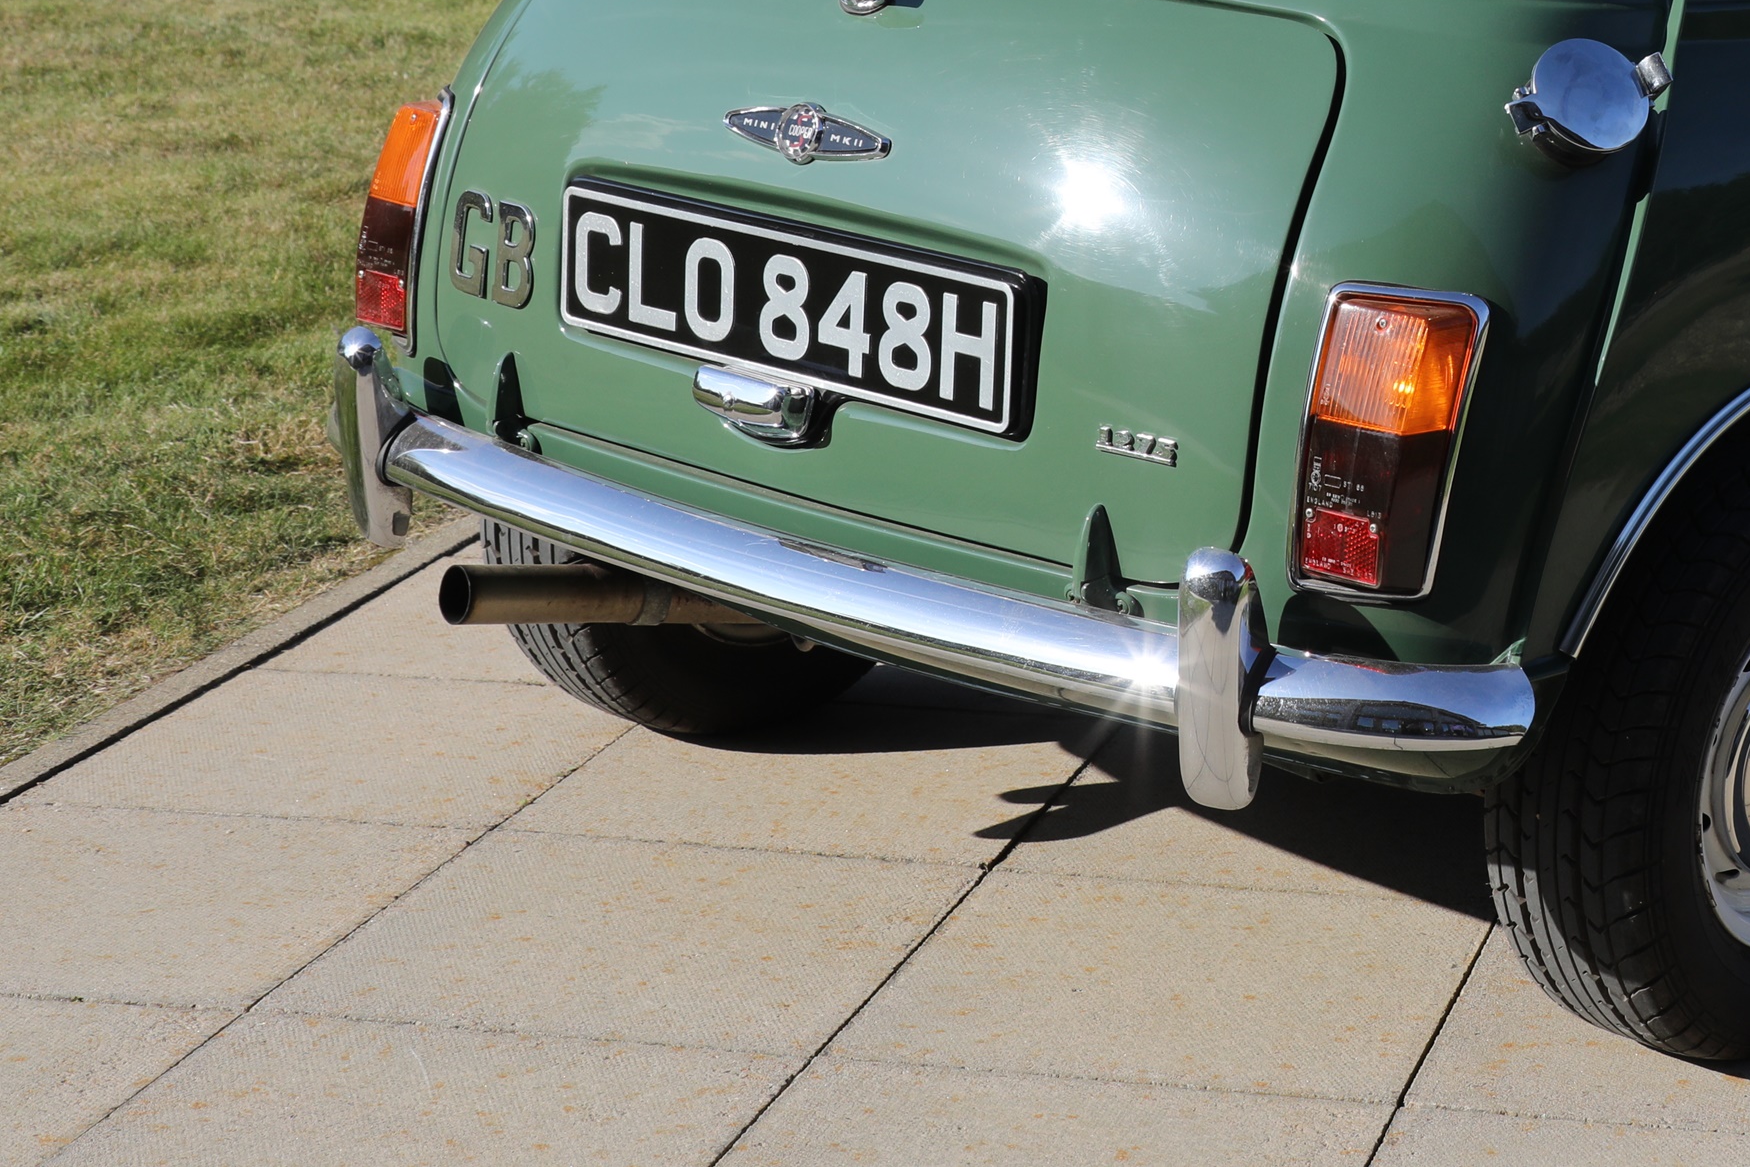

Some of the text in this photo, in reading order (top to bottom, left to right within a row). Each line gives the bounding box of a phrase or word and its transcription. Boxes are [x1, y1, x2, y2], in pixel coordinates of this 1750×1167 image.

[743, 117, 776, 131] MINI
[788, 123, 813, 139] COOPER
[449, 189, 536, 310] GB
[574, 211, 998, 411] CLO 848H
[1306, 495, 1334, 509] ENGLAND
